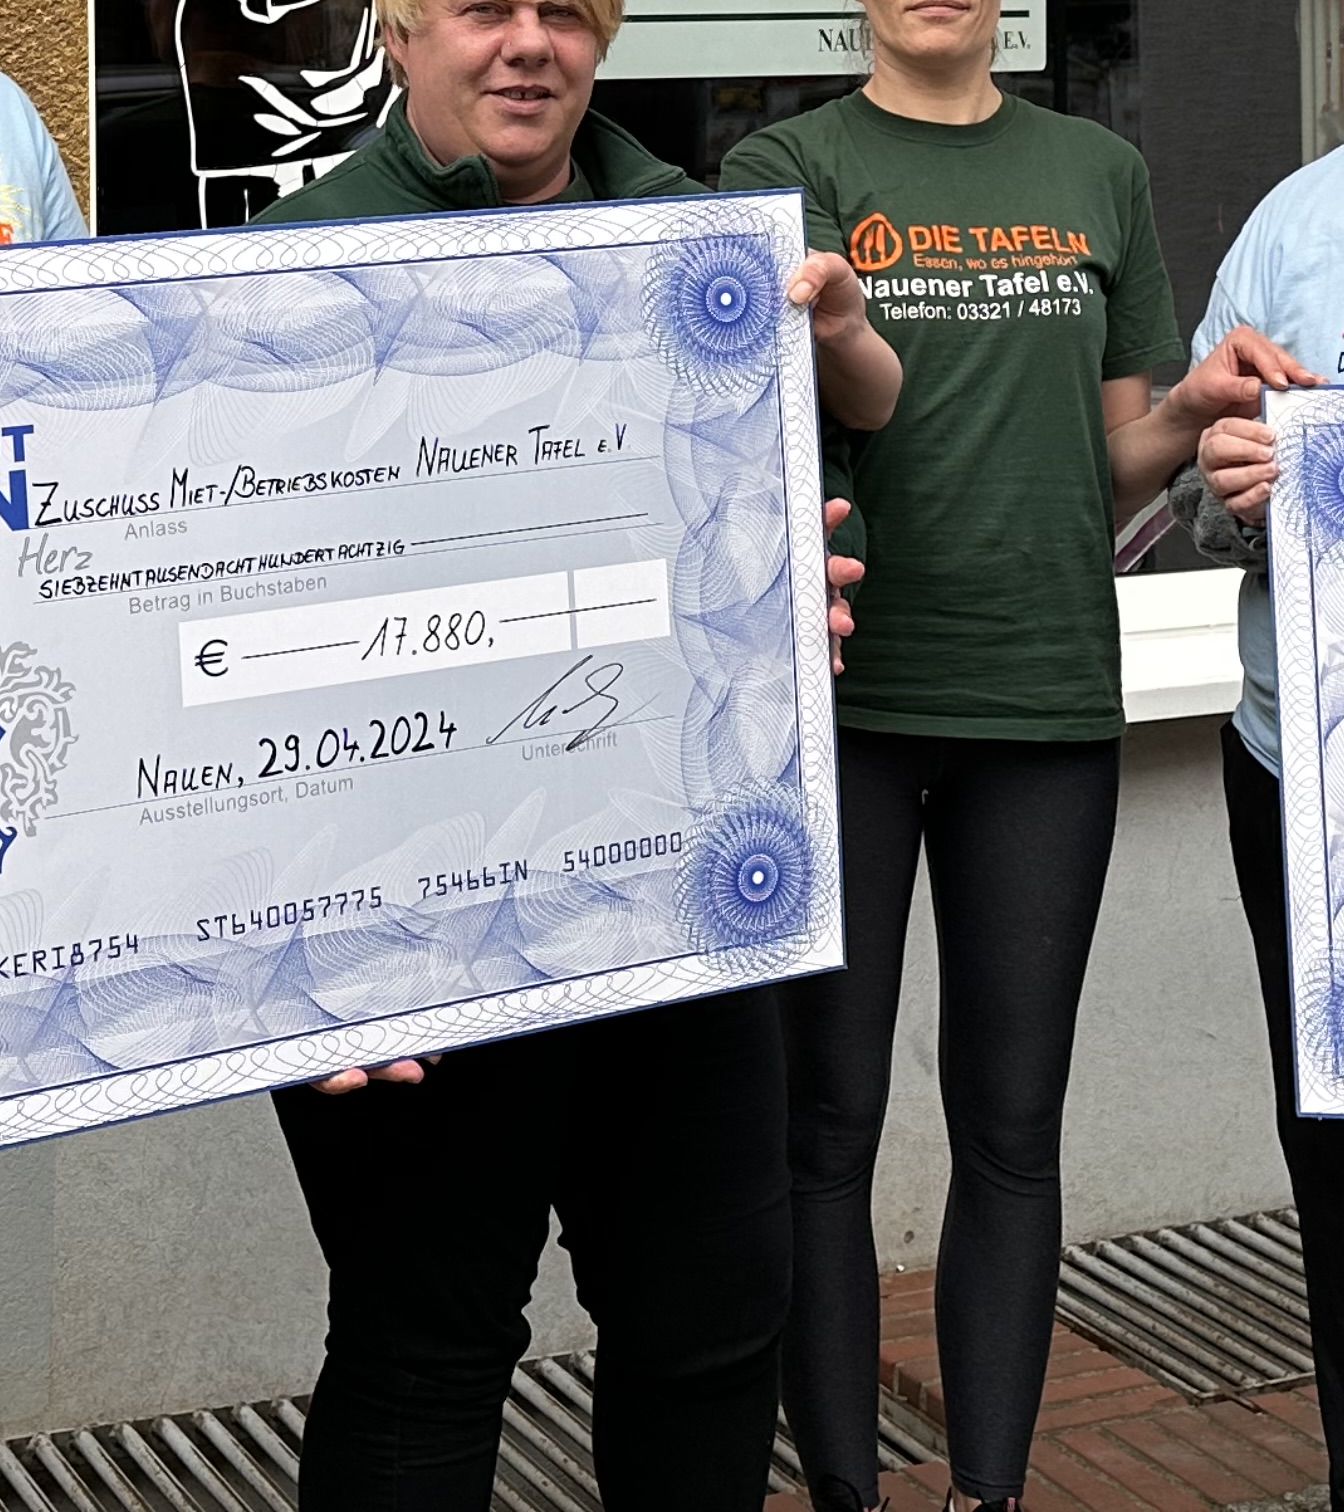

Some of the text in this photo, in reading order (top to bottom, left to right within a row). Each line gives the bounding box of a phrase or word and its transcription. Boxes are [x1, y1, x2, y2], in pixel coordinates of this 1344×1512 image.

[908, 224, 1091, 256] DIE TAFELN
[858, 270, 1094, 299] Nauener Tafel e.V.
[879, 301, 951, 320] Telefon:
[956, 302, 1010, 320] 03321
[1028, 297, 1081, 317] 48173
[124, 520, 188, 540] Anlass
[18, 533, 93, 578] Herz
[129, 576, 327, 615] Betrag in Buchstaben
[194, 639, 229, 677] €
[257, 711, 458, 779] 29.04.2024
[521, 731, 618, 762] Unterschrift
[140, 774, 354, 826] Ausstellungsort, Datum
[196, 886, 382, 942] ST640057775
[563, 832, 683, 872] 54000000
